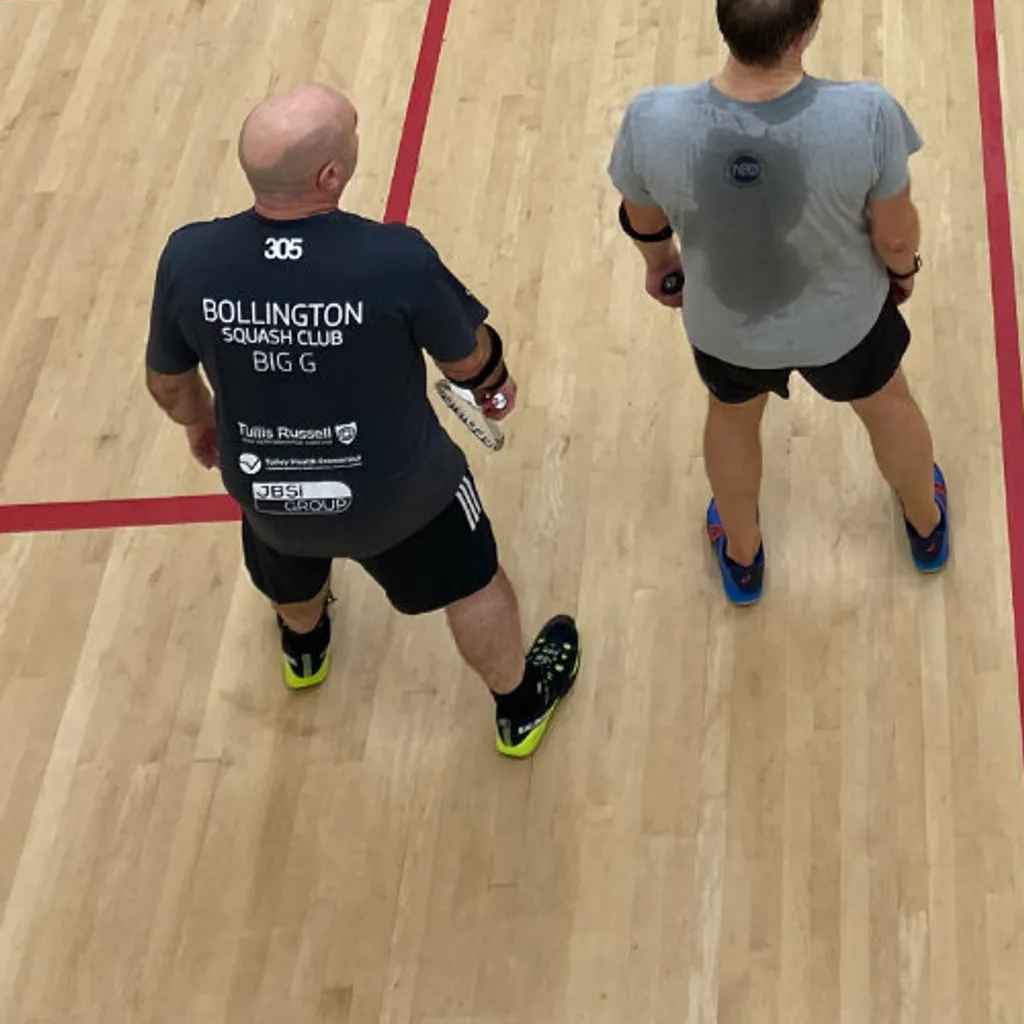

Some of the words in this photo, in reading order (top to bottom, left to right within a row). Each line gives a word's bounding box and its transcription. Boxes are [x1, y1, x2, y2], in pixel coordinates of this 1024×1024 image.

[265, 237, 303, 260] 305
[202, 298, 364, 327] BOLLINGTON
[222, 327, 293, 345] SQUASH
[297, 330, 343, 346] CLUB
[253, 350, 293, 372] BIG
[299, 352, 317, 373] G
[277, 426, 332, 439] Russell
[284, 499, 347, 512] GROUP
